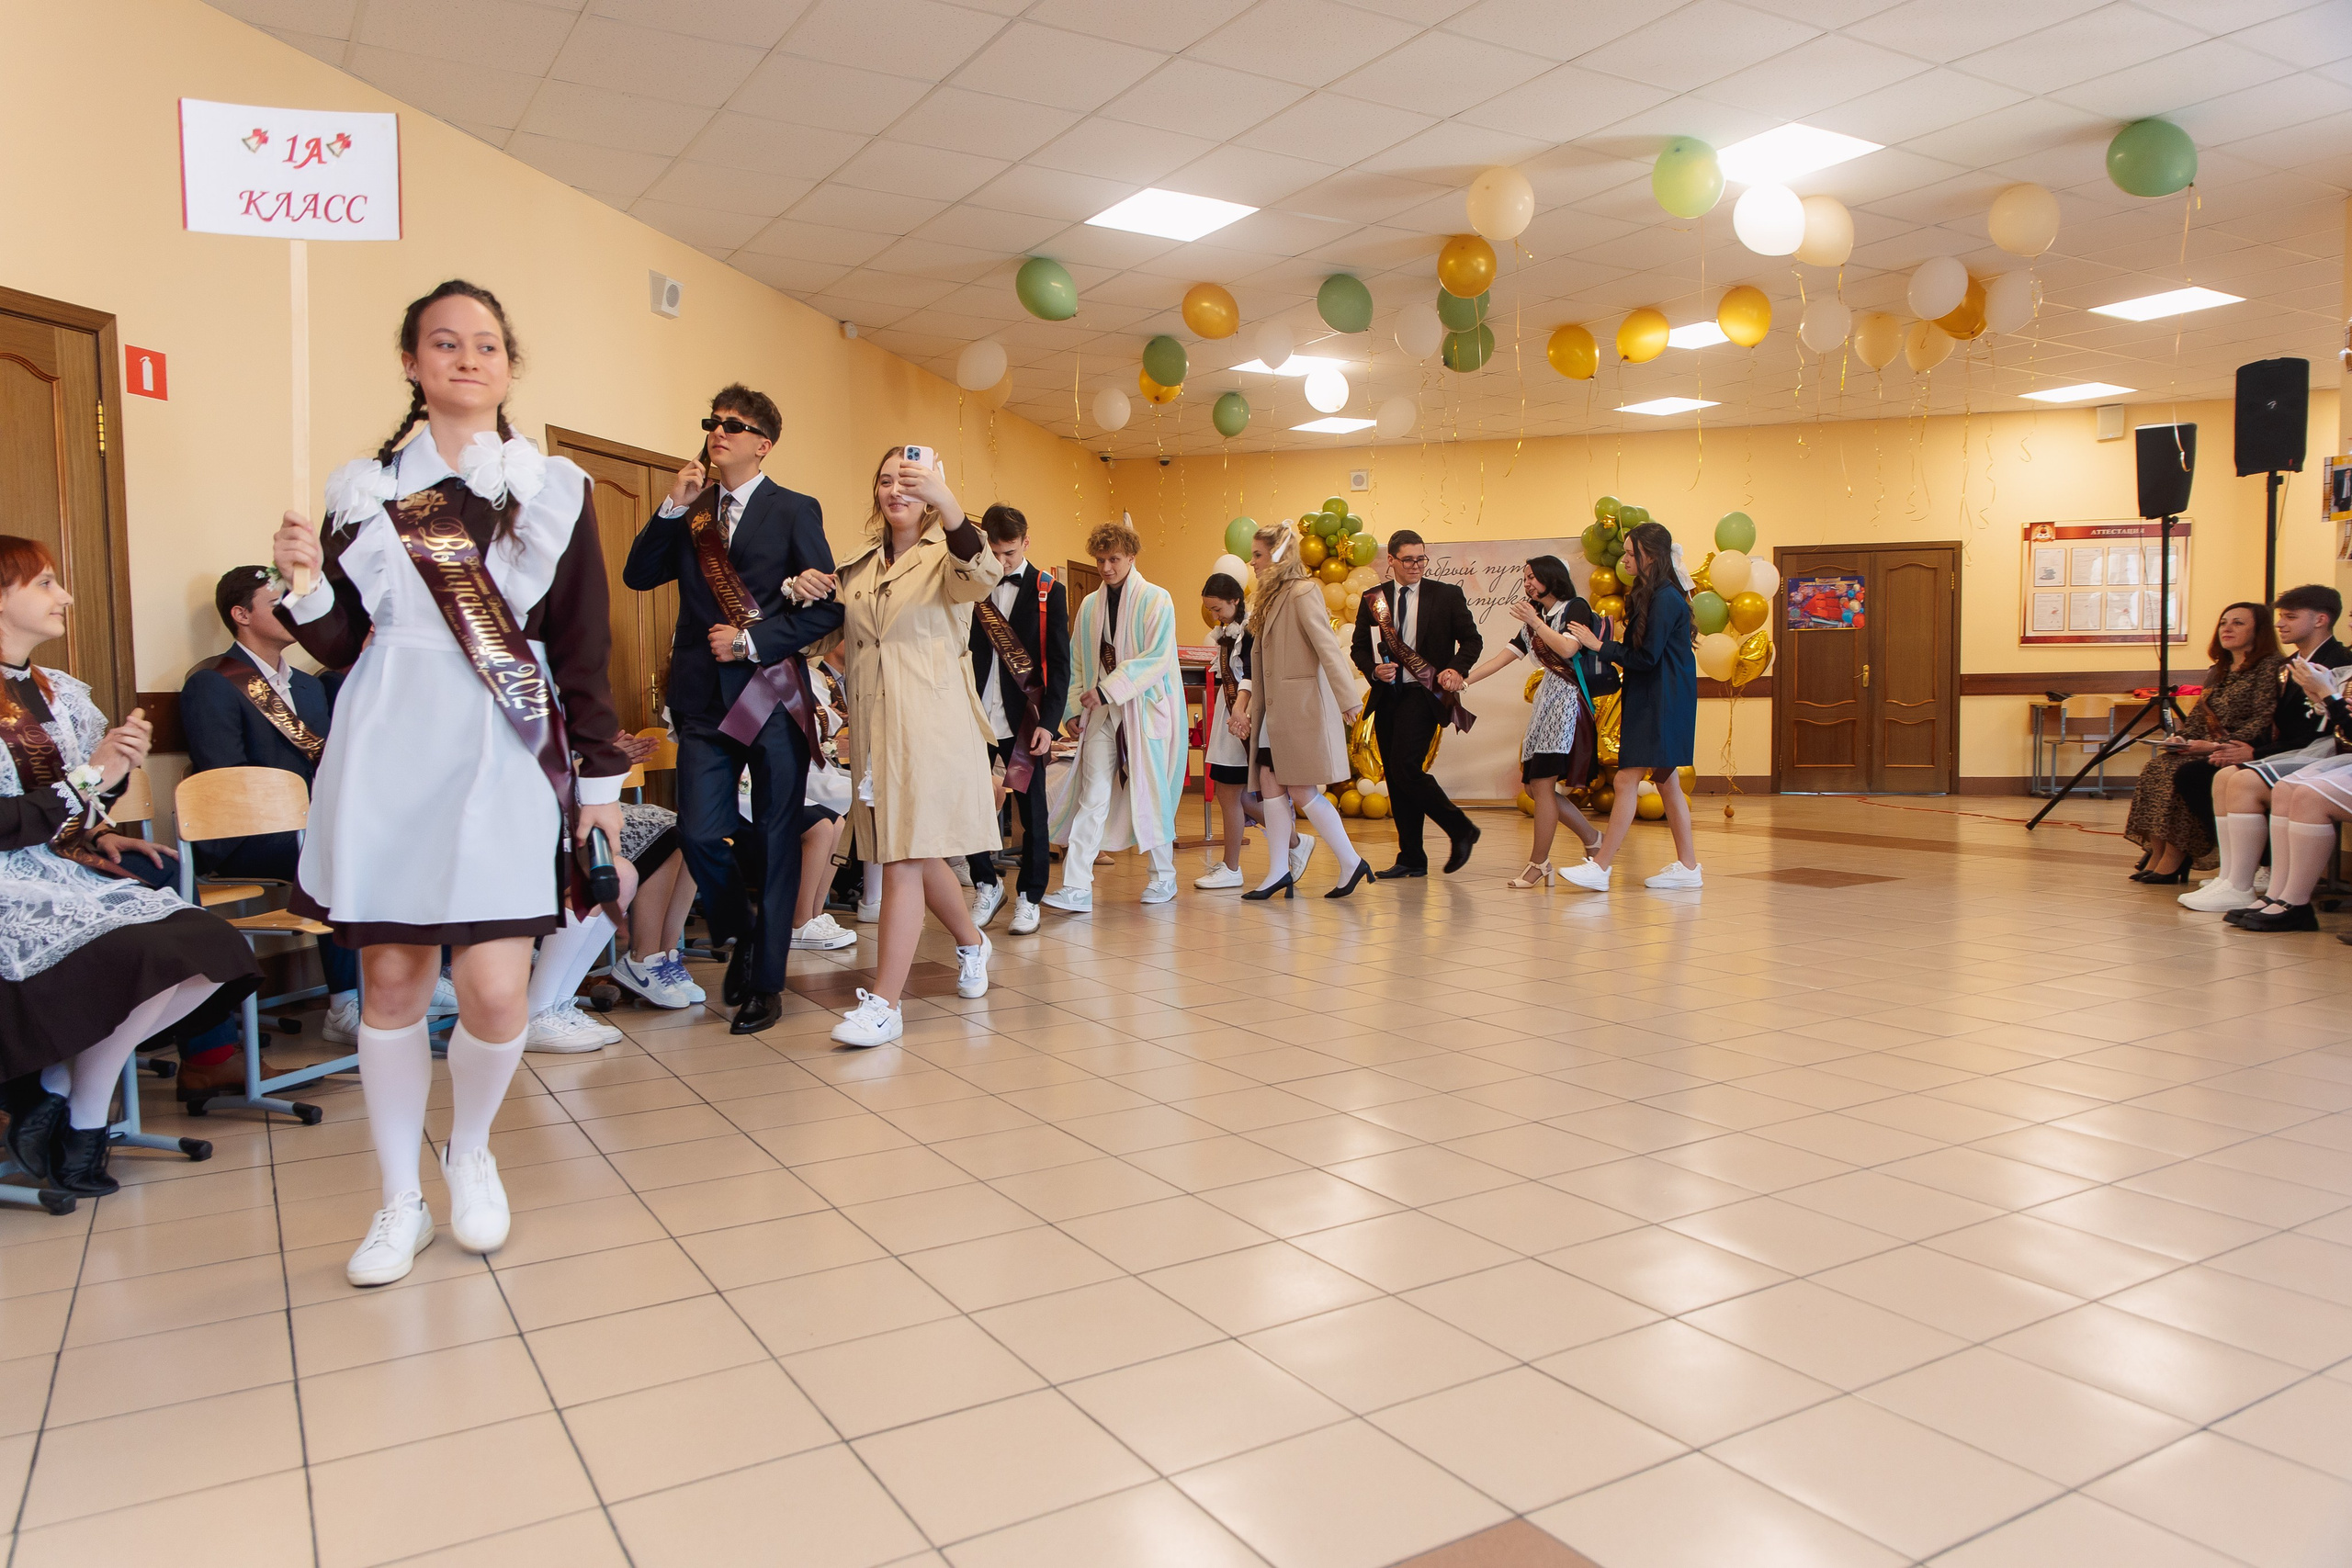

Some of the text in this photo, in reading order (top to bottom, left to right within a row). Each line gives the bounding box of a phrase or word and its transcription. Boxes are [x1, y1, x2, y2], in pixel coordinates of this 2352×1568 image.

[282, 134, 327, 169] 1А
[239, 189, 368, 223] КЛАСС
[699, 539, 745, 616] ыпускник
[736, 609, 763, 628] 20
[1483, 561, 1526, 593] пут
[418, 516, 550, 722] Выпускница 2024
[979, 603, 1014, 650] ыпускник
[1005, 648, 1035, 674] 2024
[1404, 652, 1428, 673] 2024
